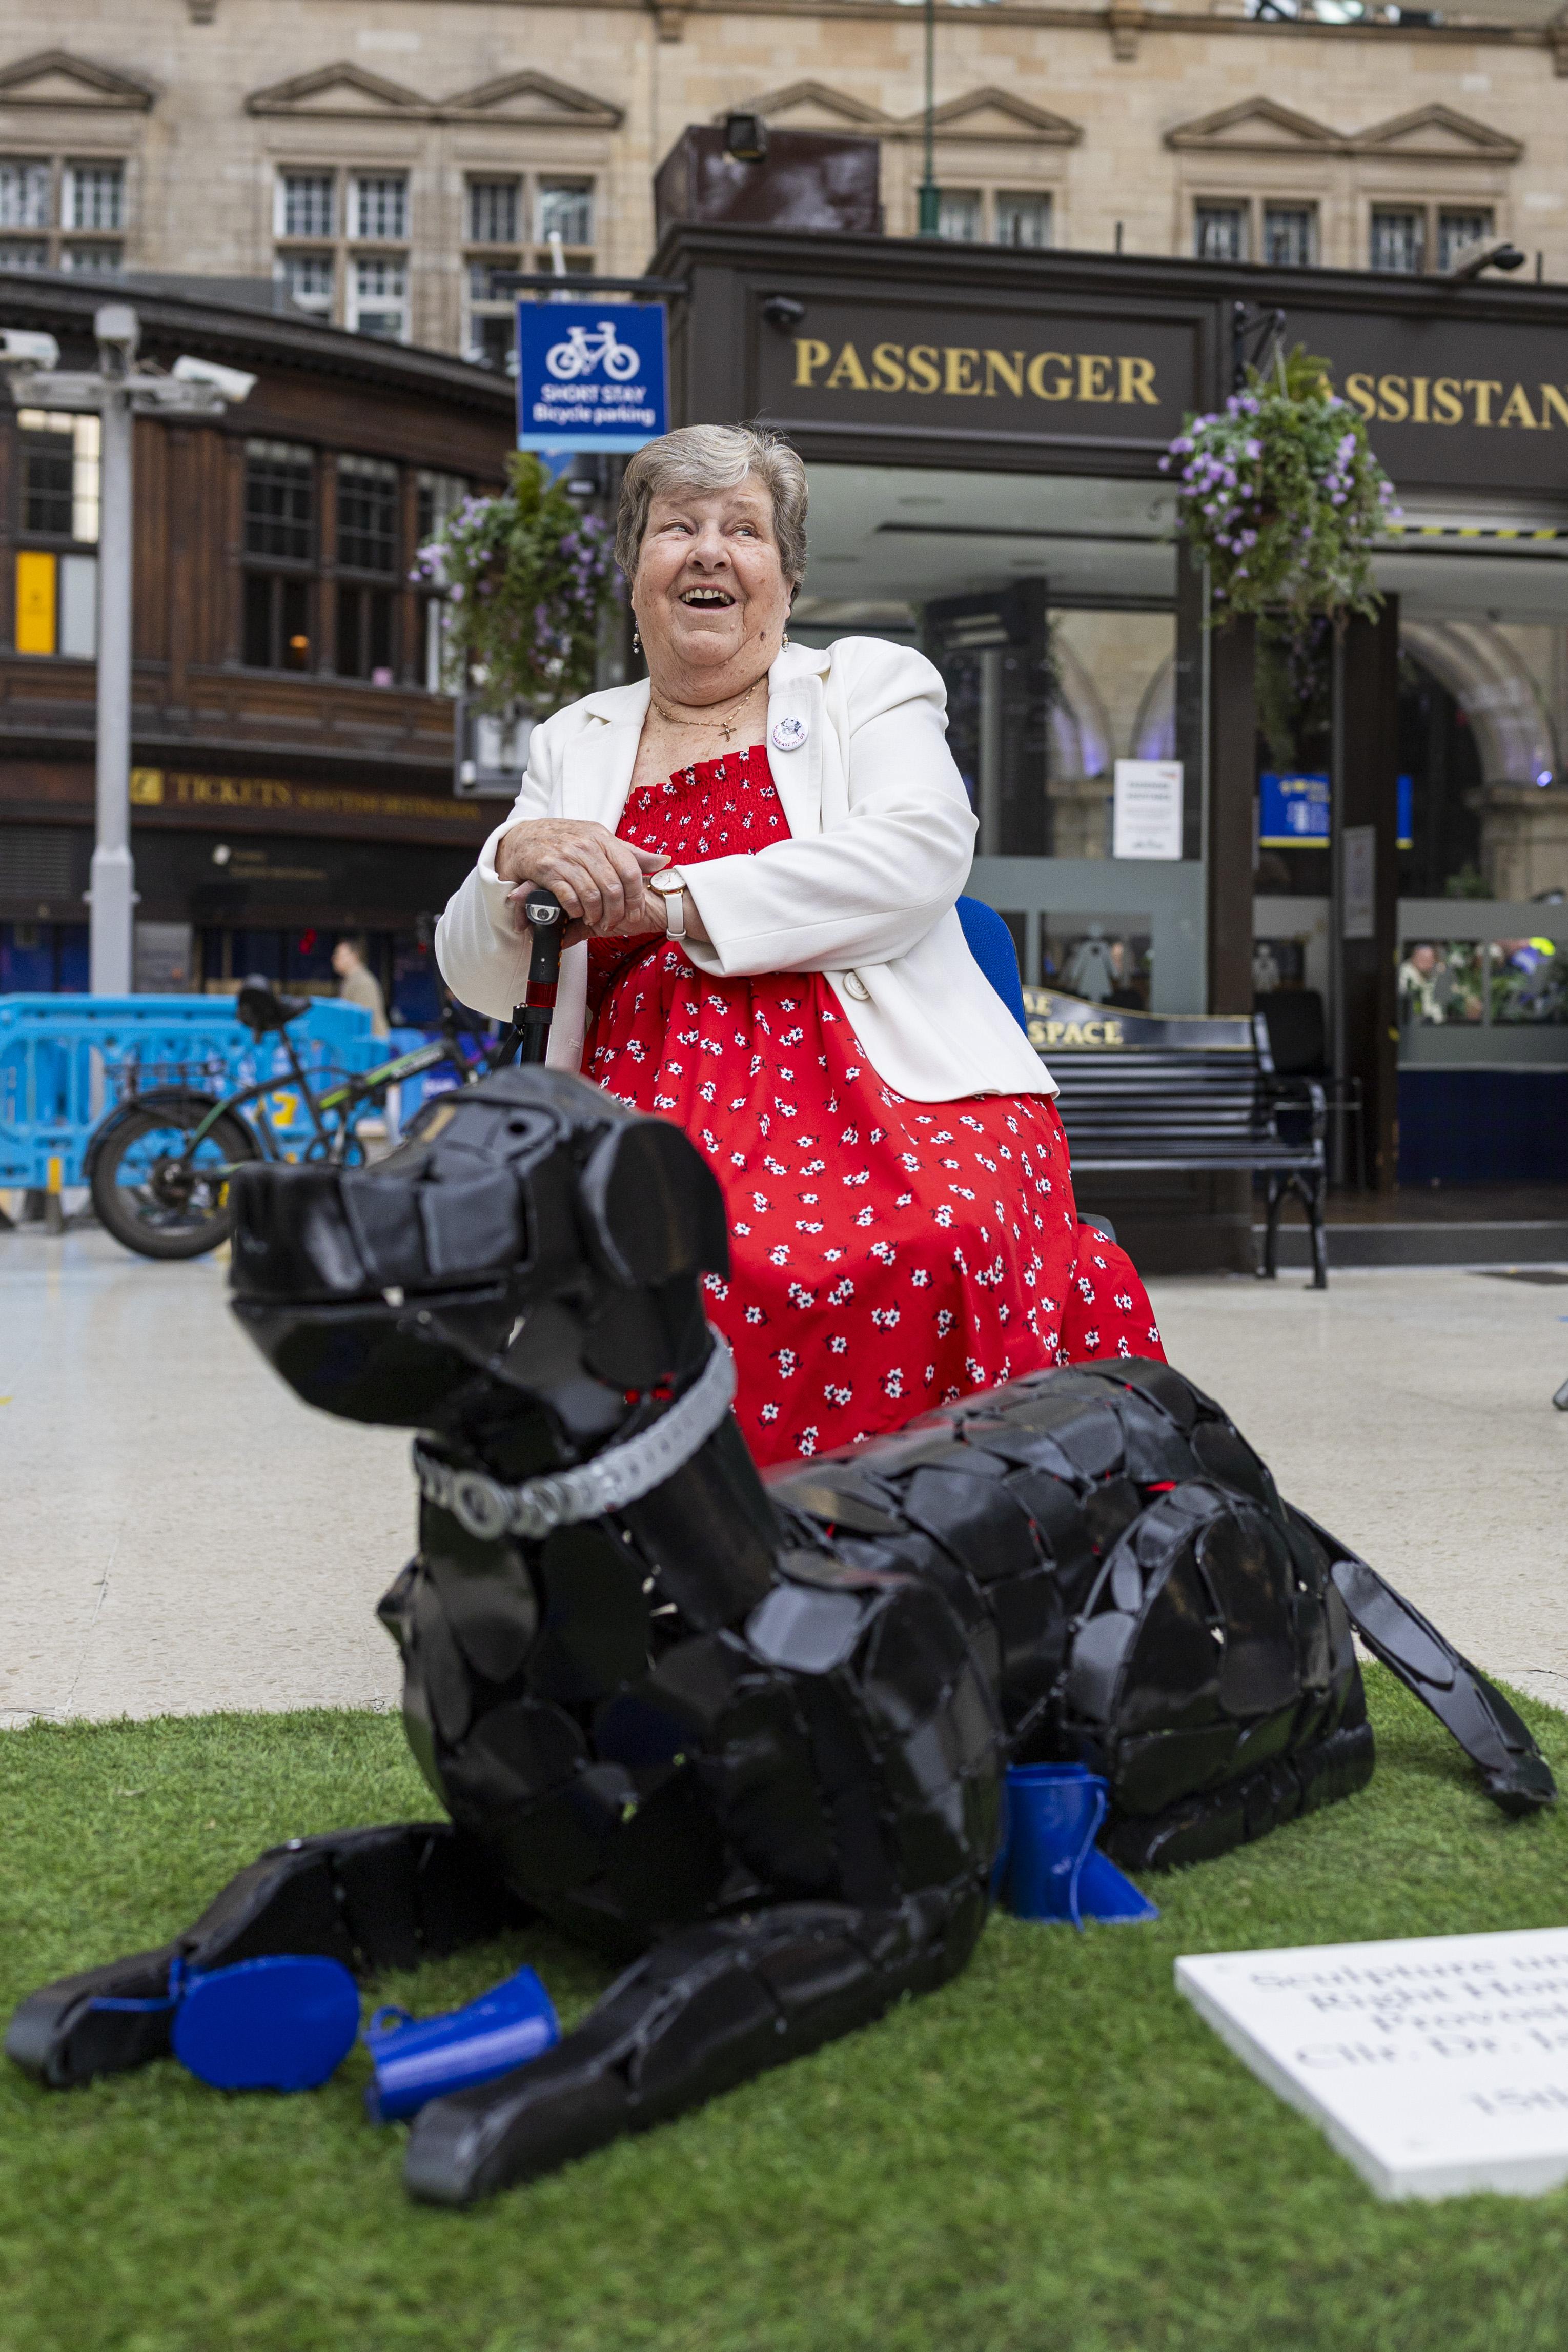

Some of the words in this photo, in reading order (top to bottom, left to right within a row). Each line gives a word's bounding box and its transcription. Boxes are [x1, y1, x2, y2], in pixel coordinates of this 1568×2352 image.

[541, 383, 600, 404] SHORT
[600, 384, 647, 404] STAY
[792, 337, 1160, 405] PASSENGER
[1318, 370, 1568, 431] SSISTAN
[533, 402, 592, 425] Bicycle
[594, 404, 656, 428] parking
[169, 772, 293, 809] TICKETS
[1028, 1020, 1124, 1046] SPACE
[1309, 1986, 1452, 2014] Right
